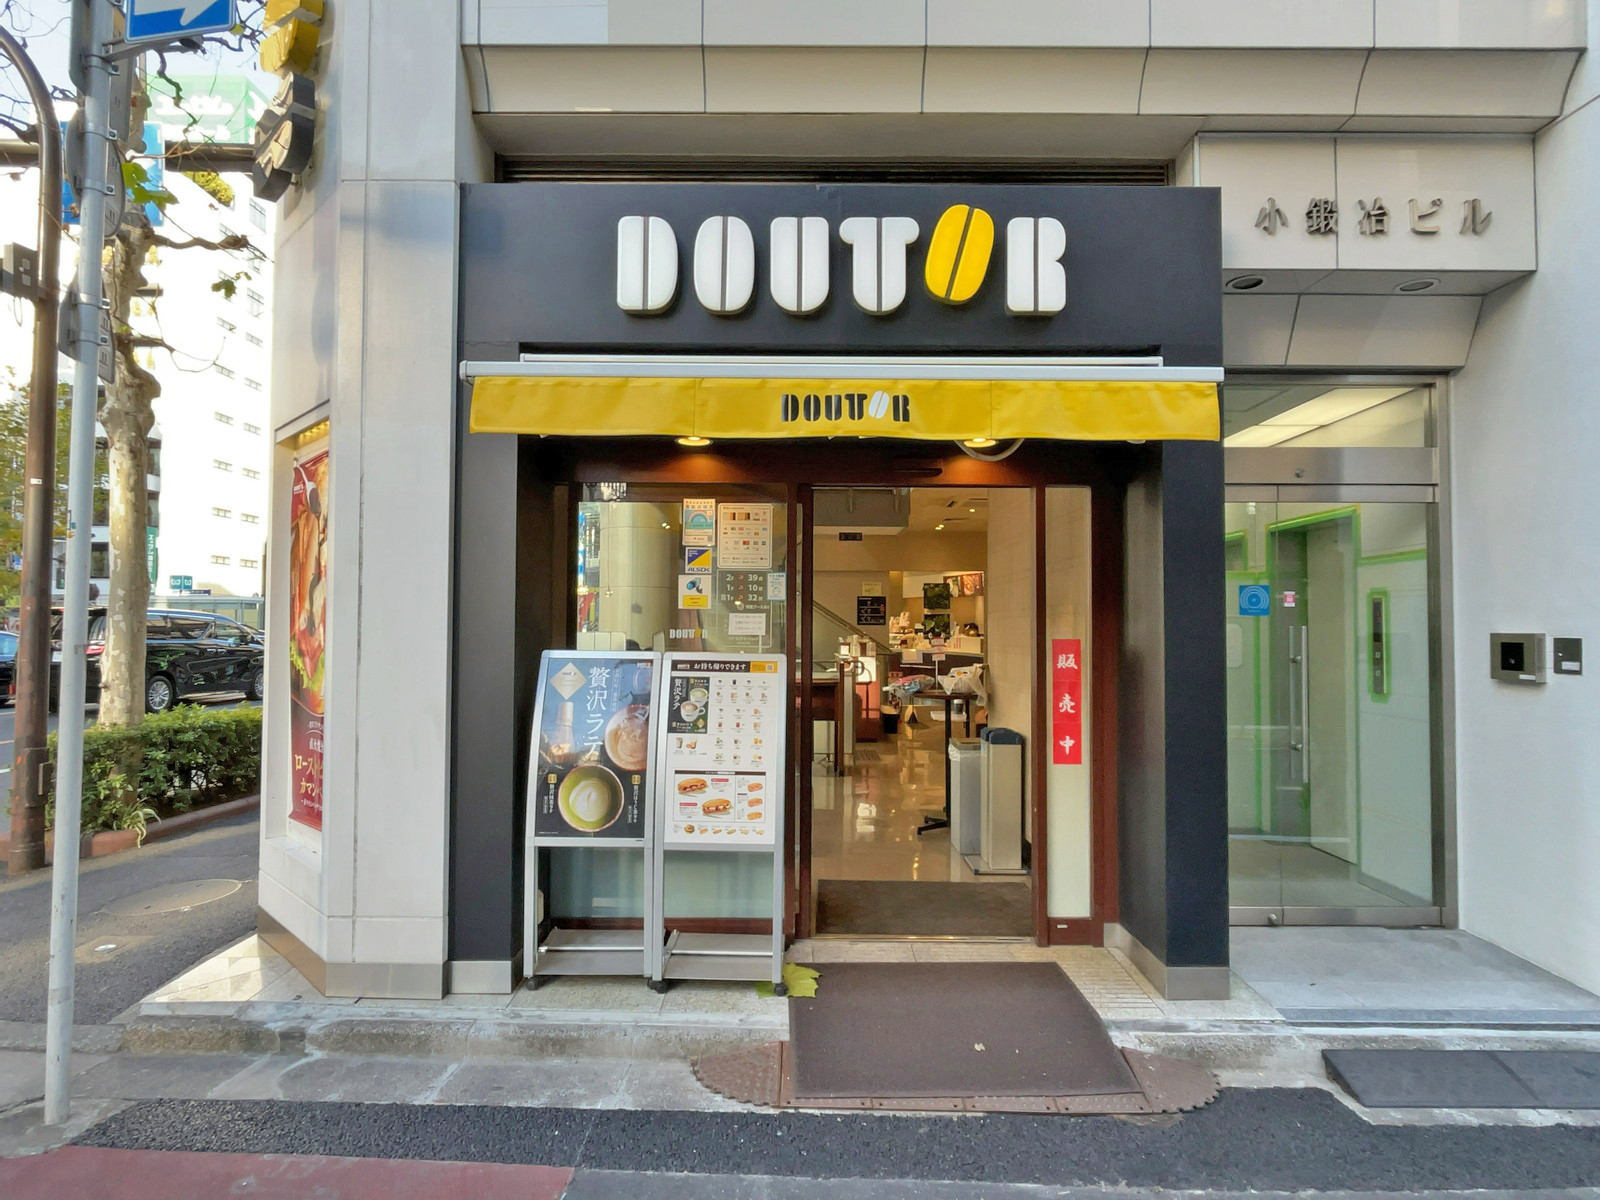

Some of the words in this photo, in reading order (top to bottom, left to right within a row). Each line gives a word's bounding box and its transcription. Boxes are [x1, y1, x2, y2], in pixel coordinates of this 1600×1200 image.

[1253, 195, 1493, 238] 小鍛冶ビル
[616, 204, 1067, 316] DOUTOR
[781, 389, 911, 423] DOUTOR
[693, 662, 747, 671] お持ち帰りできます
[583, 666, 611, 758] 贅沢ラテ
[1056, 652, 1079, 756] 販売中
